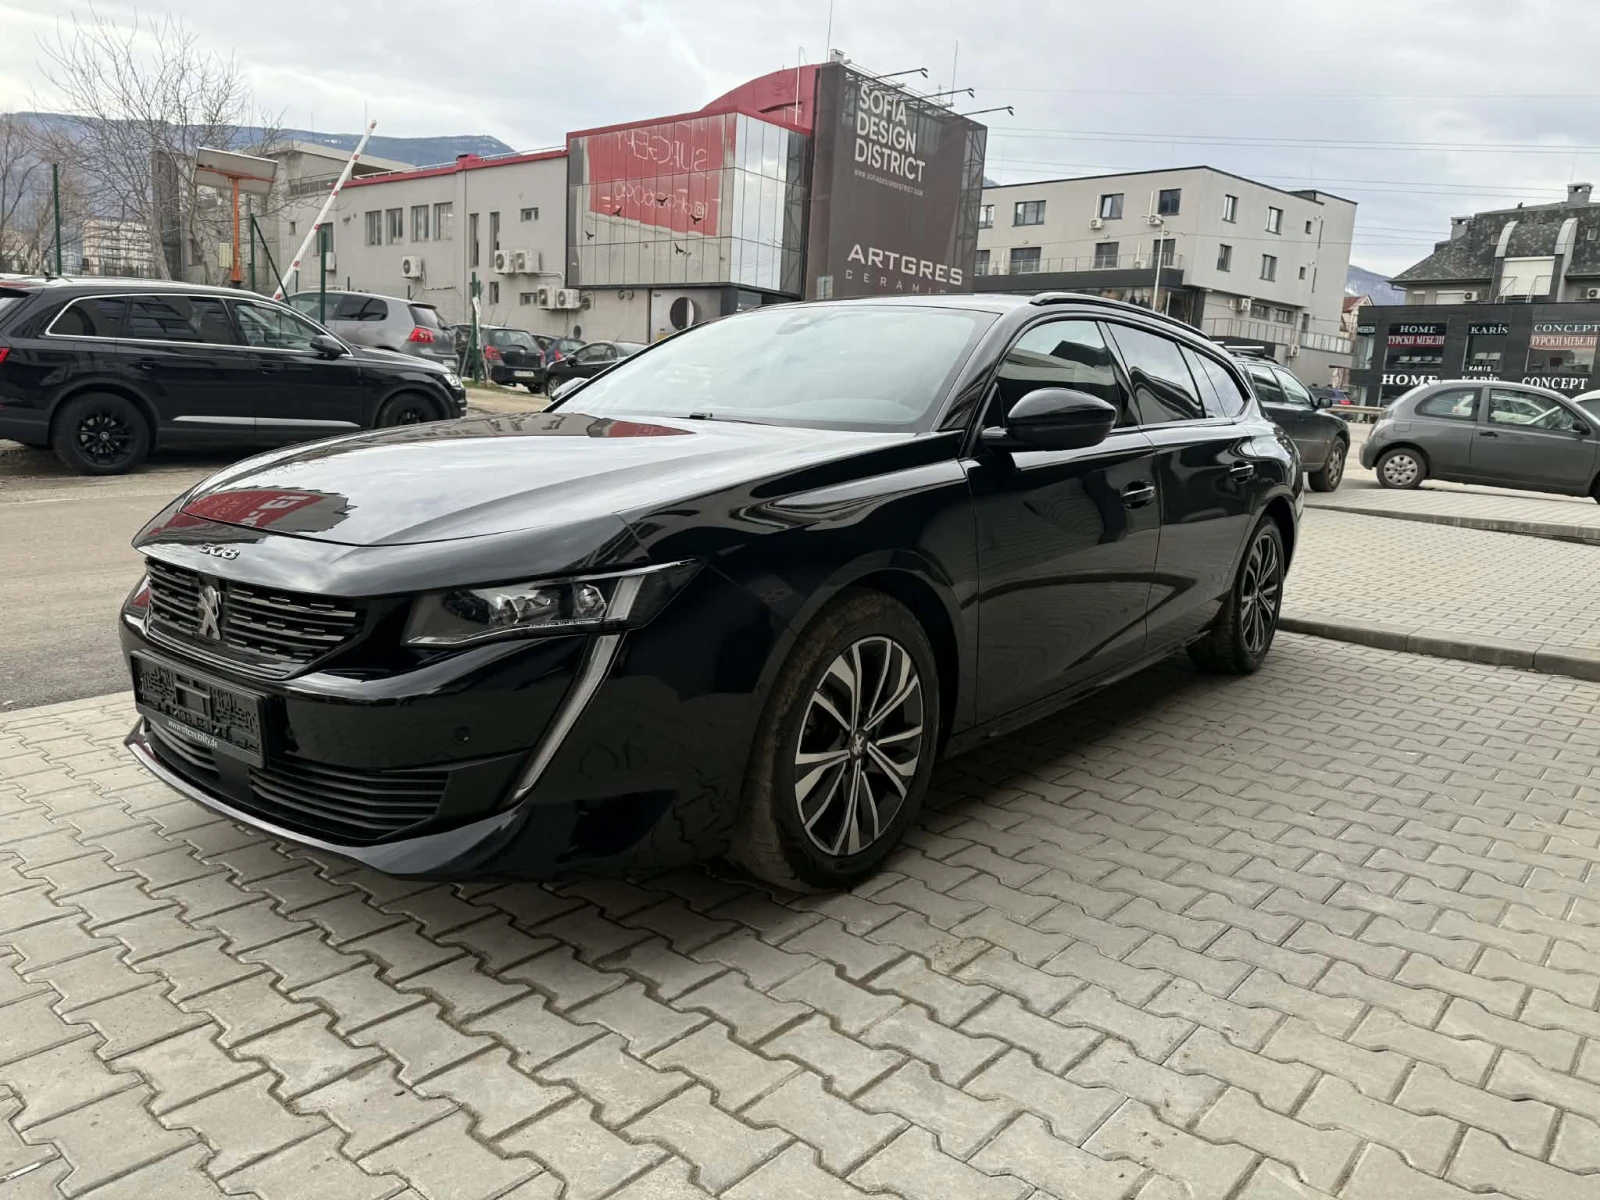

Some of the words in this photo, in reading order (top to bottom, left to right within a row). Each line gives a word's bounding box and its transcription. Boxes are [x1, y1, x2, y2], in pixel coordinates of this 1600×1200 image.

[859, 86, 907, 125] SOFIA
[857, 111, 916, 154] DESIGN
[855, 140, 926, 182] DISTRICT
[847, 243, 963, 286] ARTGRES
[1400, 325, 1437, 333] HOME
[1534, 324, 1600, 333] CONCEPT
[1522, 376, 1588, 390] CONCEPT
[199, 542, 240, 560] 508
